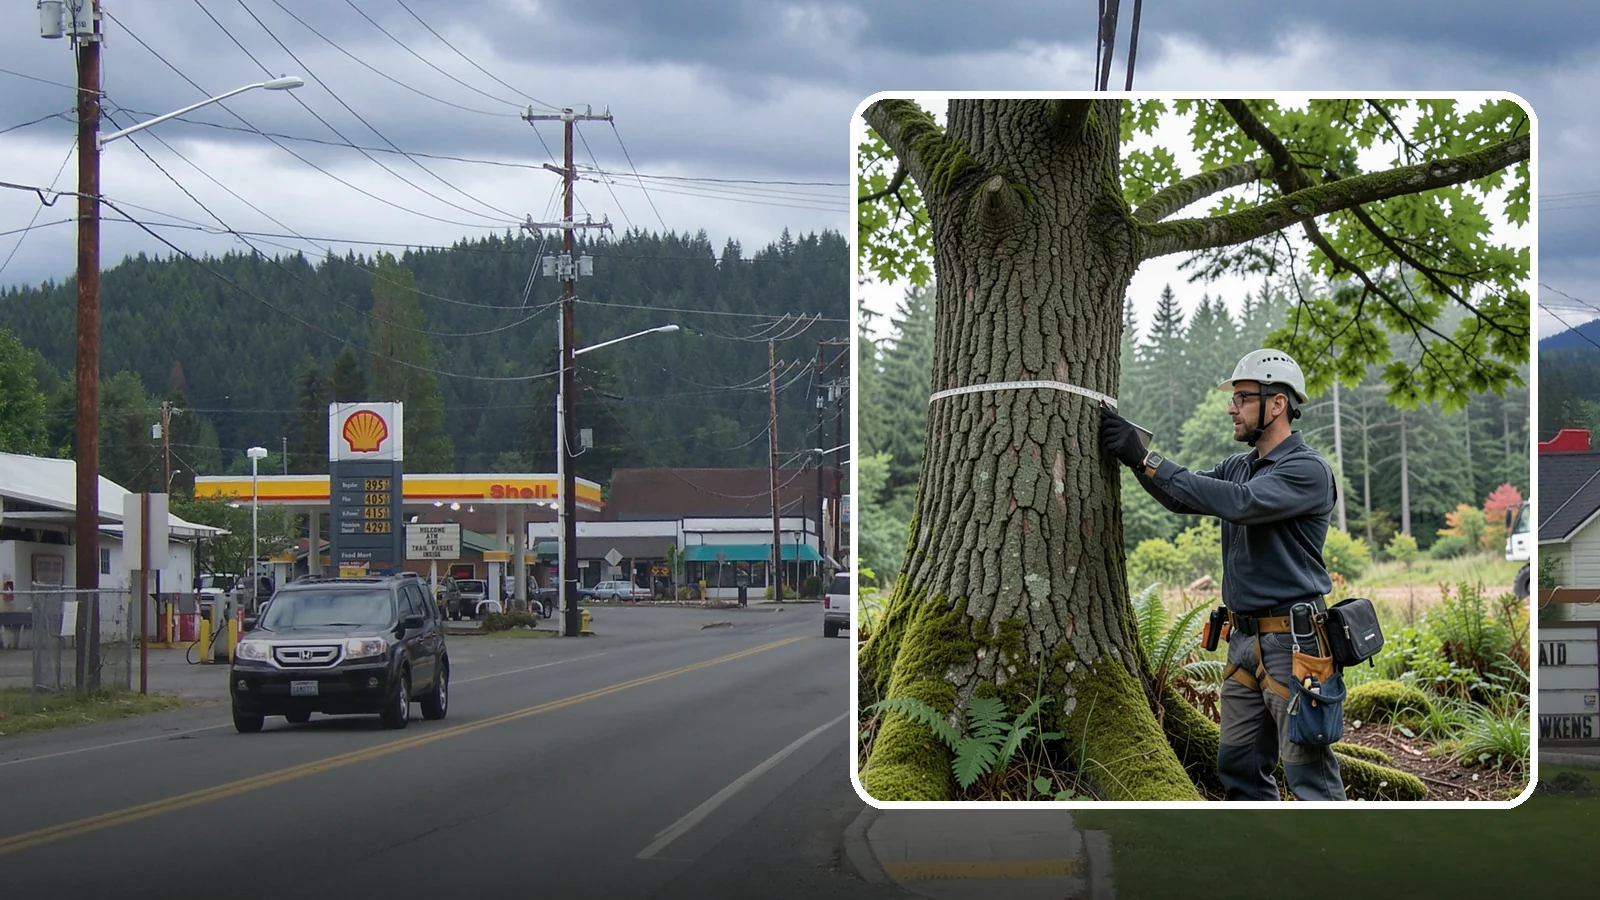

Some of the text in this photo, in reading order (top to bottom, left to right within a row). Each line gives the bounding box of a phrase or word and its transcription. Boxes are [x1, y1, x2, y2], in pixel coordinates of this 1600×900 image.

[366, 480, 383, 490] 395
[490, 484, 547, 499] Shell
[366, 494, 383, 504] 405
[366, 522, 383, 532] 429
